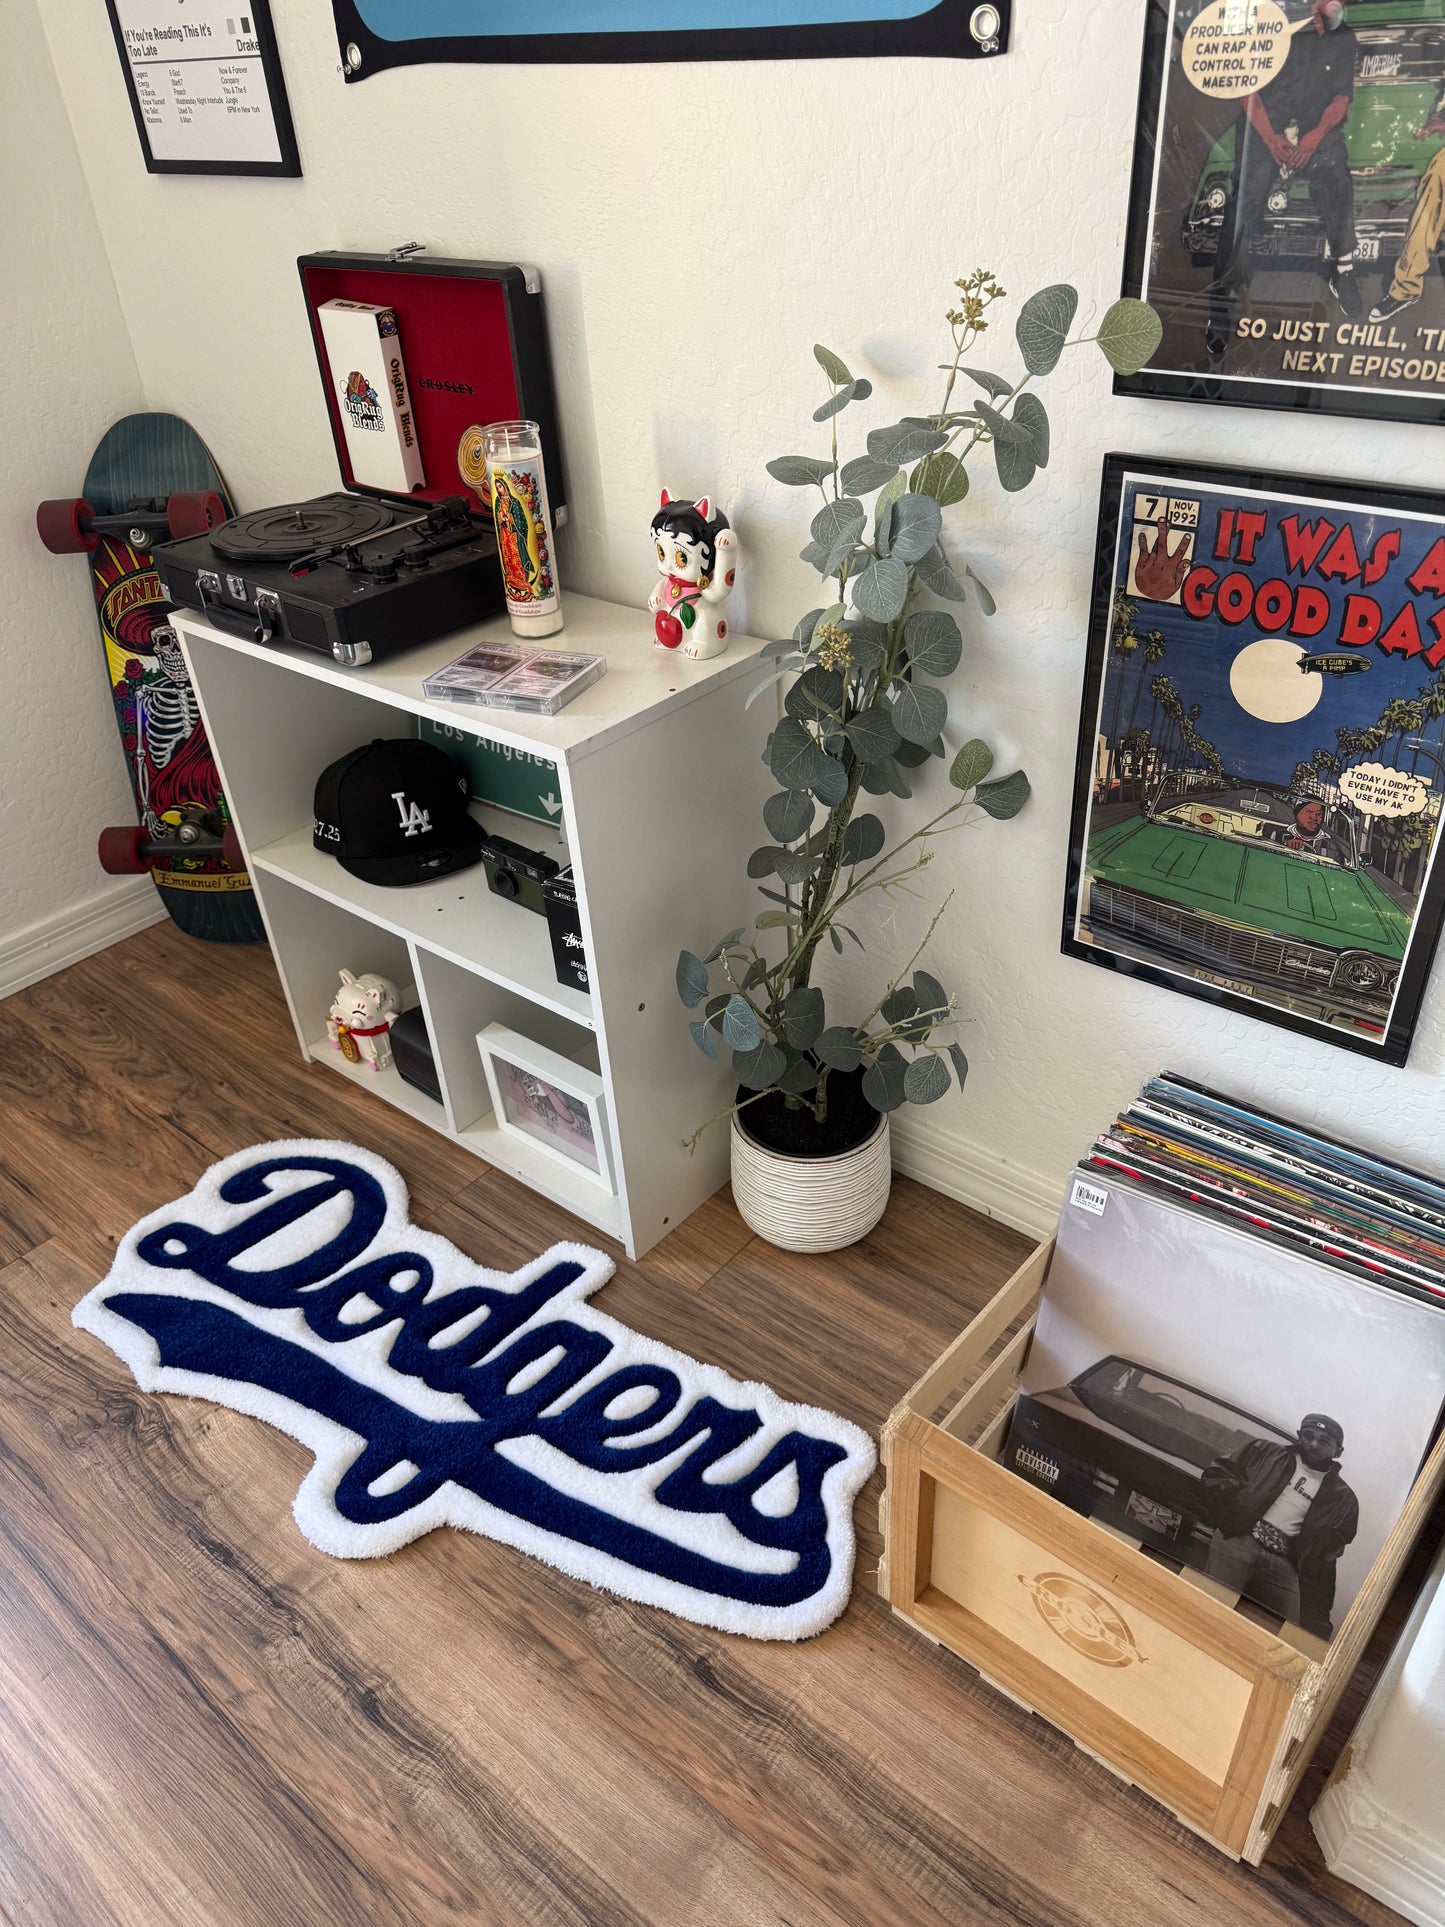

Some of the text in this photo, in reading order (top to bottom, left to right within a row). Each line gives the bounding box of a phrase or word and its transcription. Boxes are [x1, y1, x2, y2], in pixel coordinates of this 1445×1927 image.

[125, 23, 212, 43] If You're Reading This It's
[1190, 20, 1284, 39] PRODUCER WHO
[128, 44, 158, 58] Too Late
[236, 38, 260, 52] Drake
[1195, 39, 1274, 56] CAN RAP AND
[1191, 57, 1275, 73] CONTROL THE
[220, 76, 240, 86] Company
[223, 86, 231, 94] You
[235, 85, 244, 94] The
[1201, 75, 1258, 89] MAESTRO
[1236, 317, 1267, 339] SO
[1272, 319, 1330, 344] JUST
[1335, 323, 1407, 352] CHILL,
[1282, 349, 1445, 384] NEXT EPISODE
[418, 377, 474, 396] CROSLEY
[344, 397, 384, 421] OrigRug
[391, 358, 414, 449] OrigRug Blends
[351, 412, 385, 432] Blends
[1145, 497, 1159, 519] 7
[1173, 501, 1196, 512] NOV.
[1168, 510, 1197, 525] 1992
[1212, 507, 1445, 598] IT WAS A
[1180, 565, 1331, 639] GOOD
[433, 720, 464, 742] Los
[1347, 780, 1416, 803] EVEN HAVE TO
[1350, 770, 1419, 793] TODAY I DIDN'T
[1355, 792, 1404, 810] USE MY AK
[391, 791, 433, 837] LA
[158, 872, 221, 889] Emmanuel
[100, 1154, 852, 1610] Dodgers
[1018, 1450, 1058, 1477] ADVISORY
